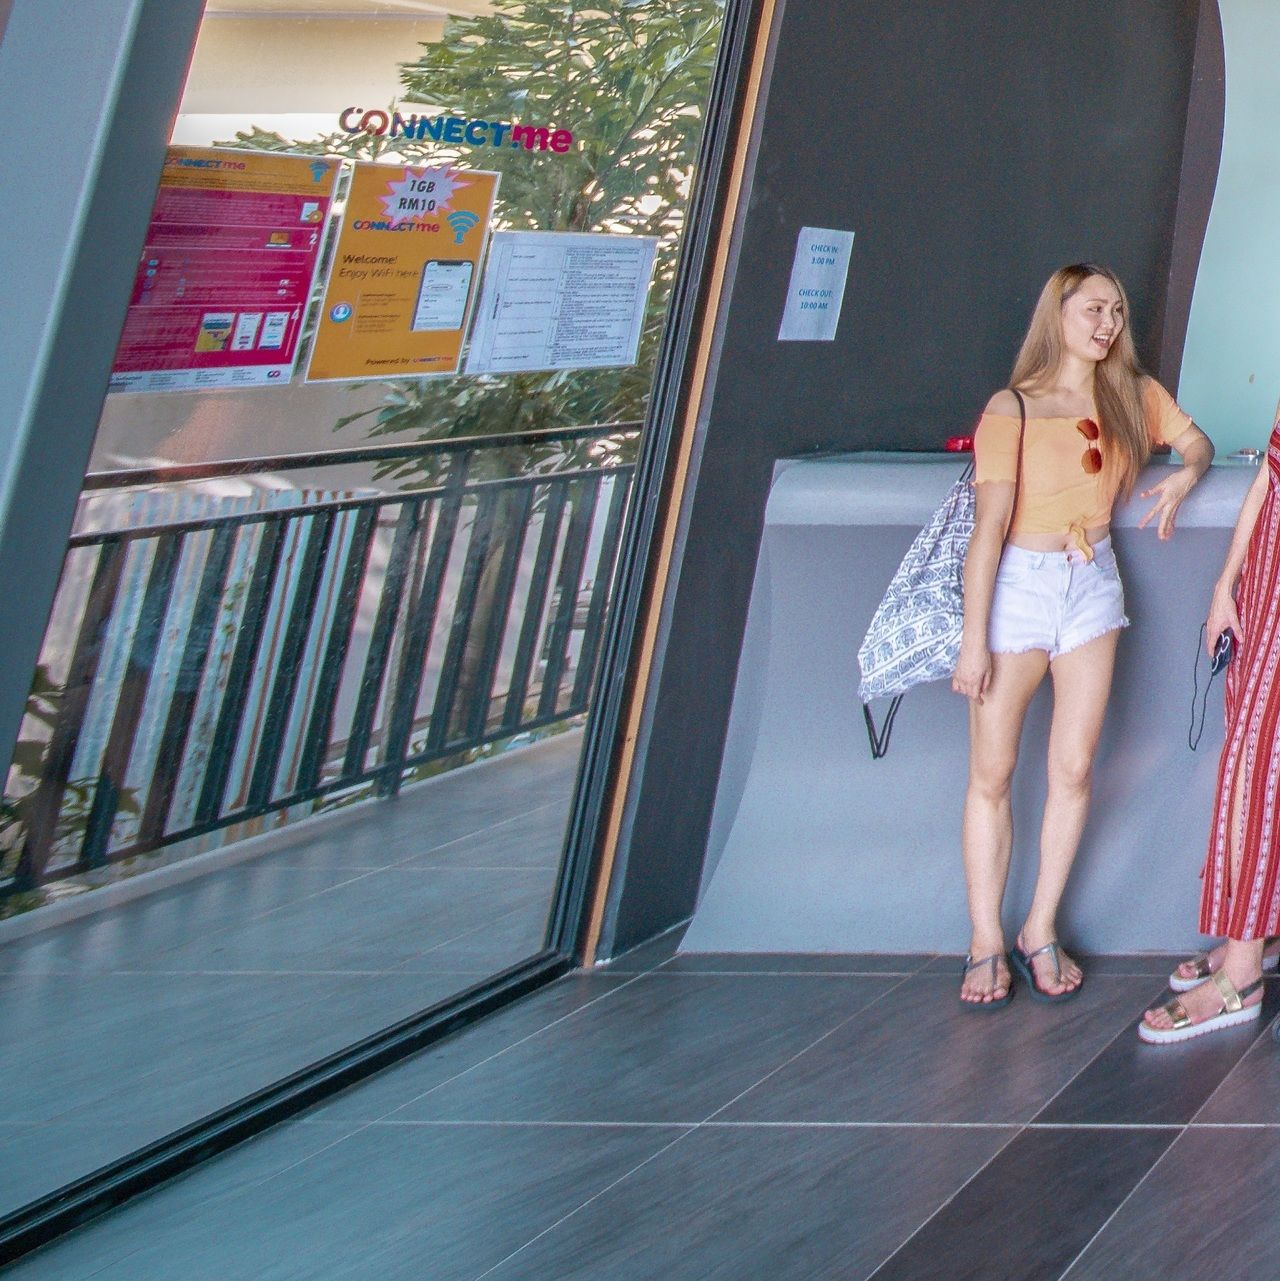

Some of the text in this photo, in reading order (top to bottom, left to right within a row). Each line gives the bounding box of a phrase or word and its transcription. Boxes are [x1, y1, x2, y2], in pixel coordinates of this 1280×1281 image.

[410, 179, 436, 192] 1GB
[399, 198, 436, 211] RM10
[310, 233, 317, 245] 2
[811, 244, 831, 254] CHECK
[811, 257, 825, 265] 3:00
[339, 268, 368, 280] Enjoy
[798, 288, 820, 297] CHECK
[800, 302, 817, 310] 10:00
